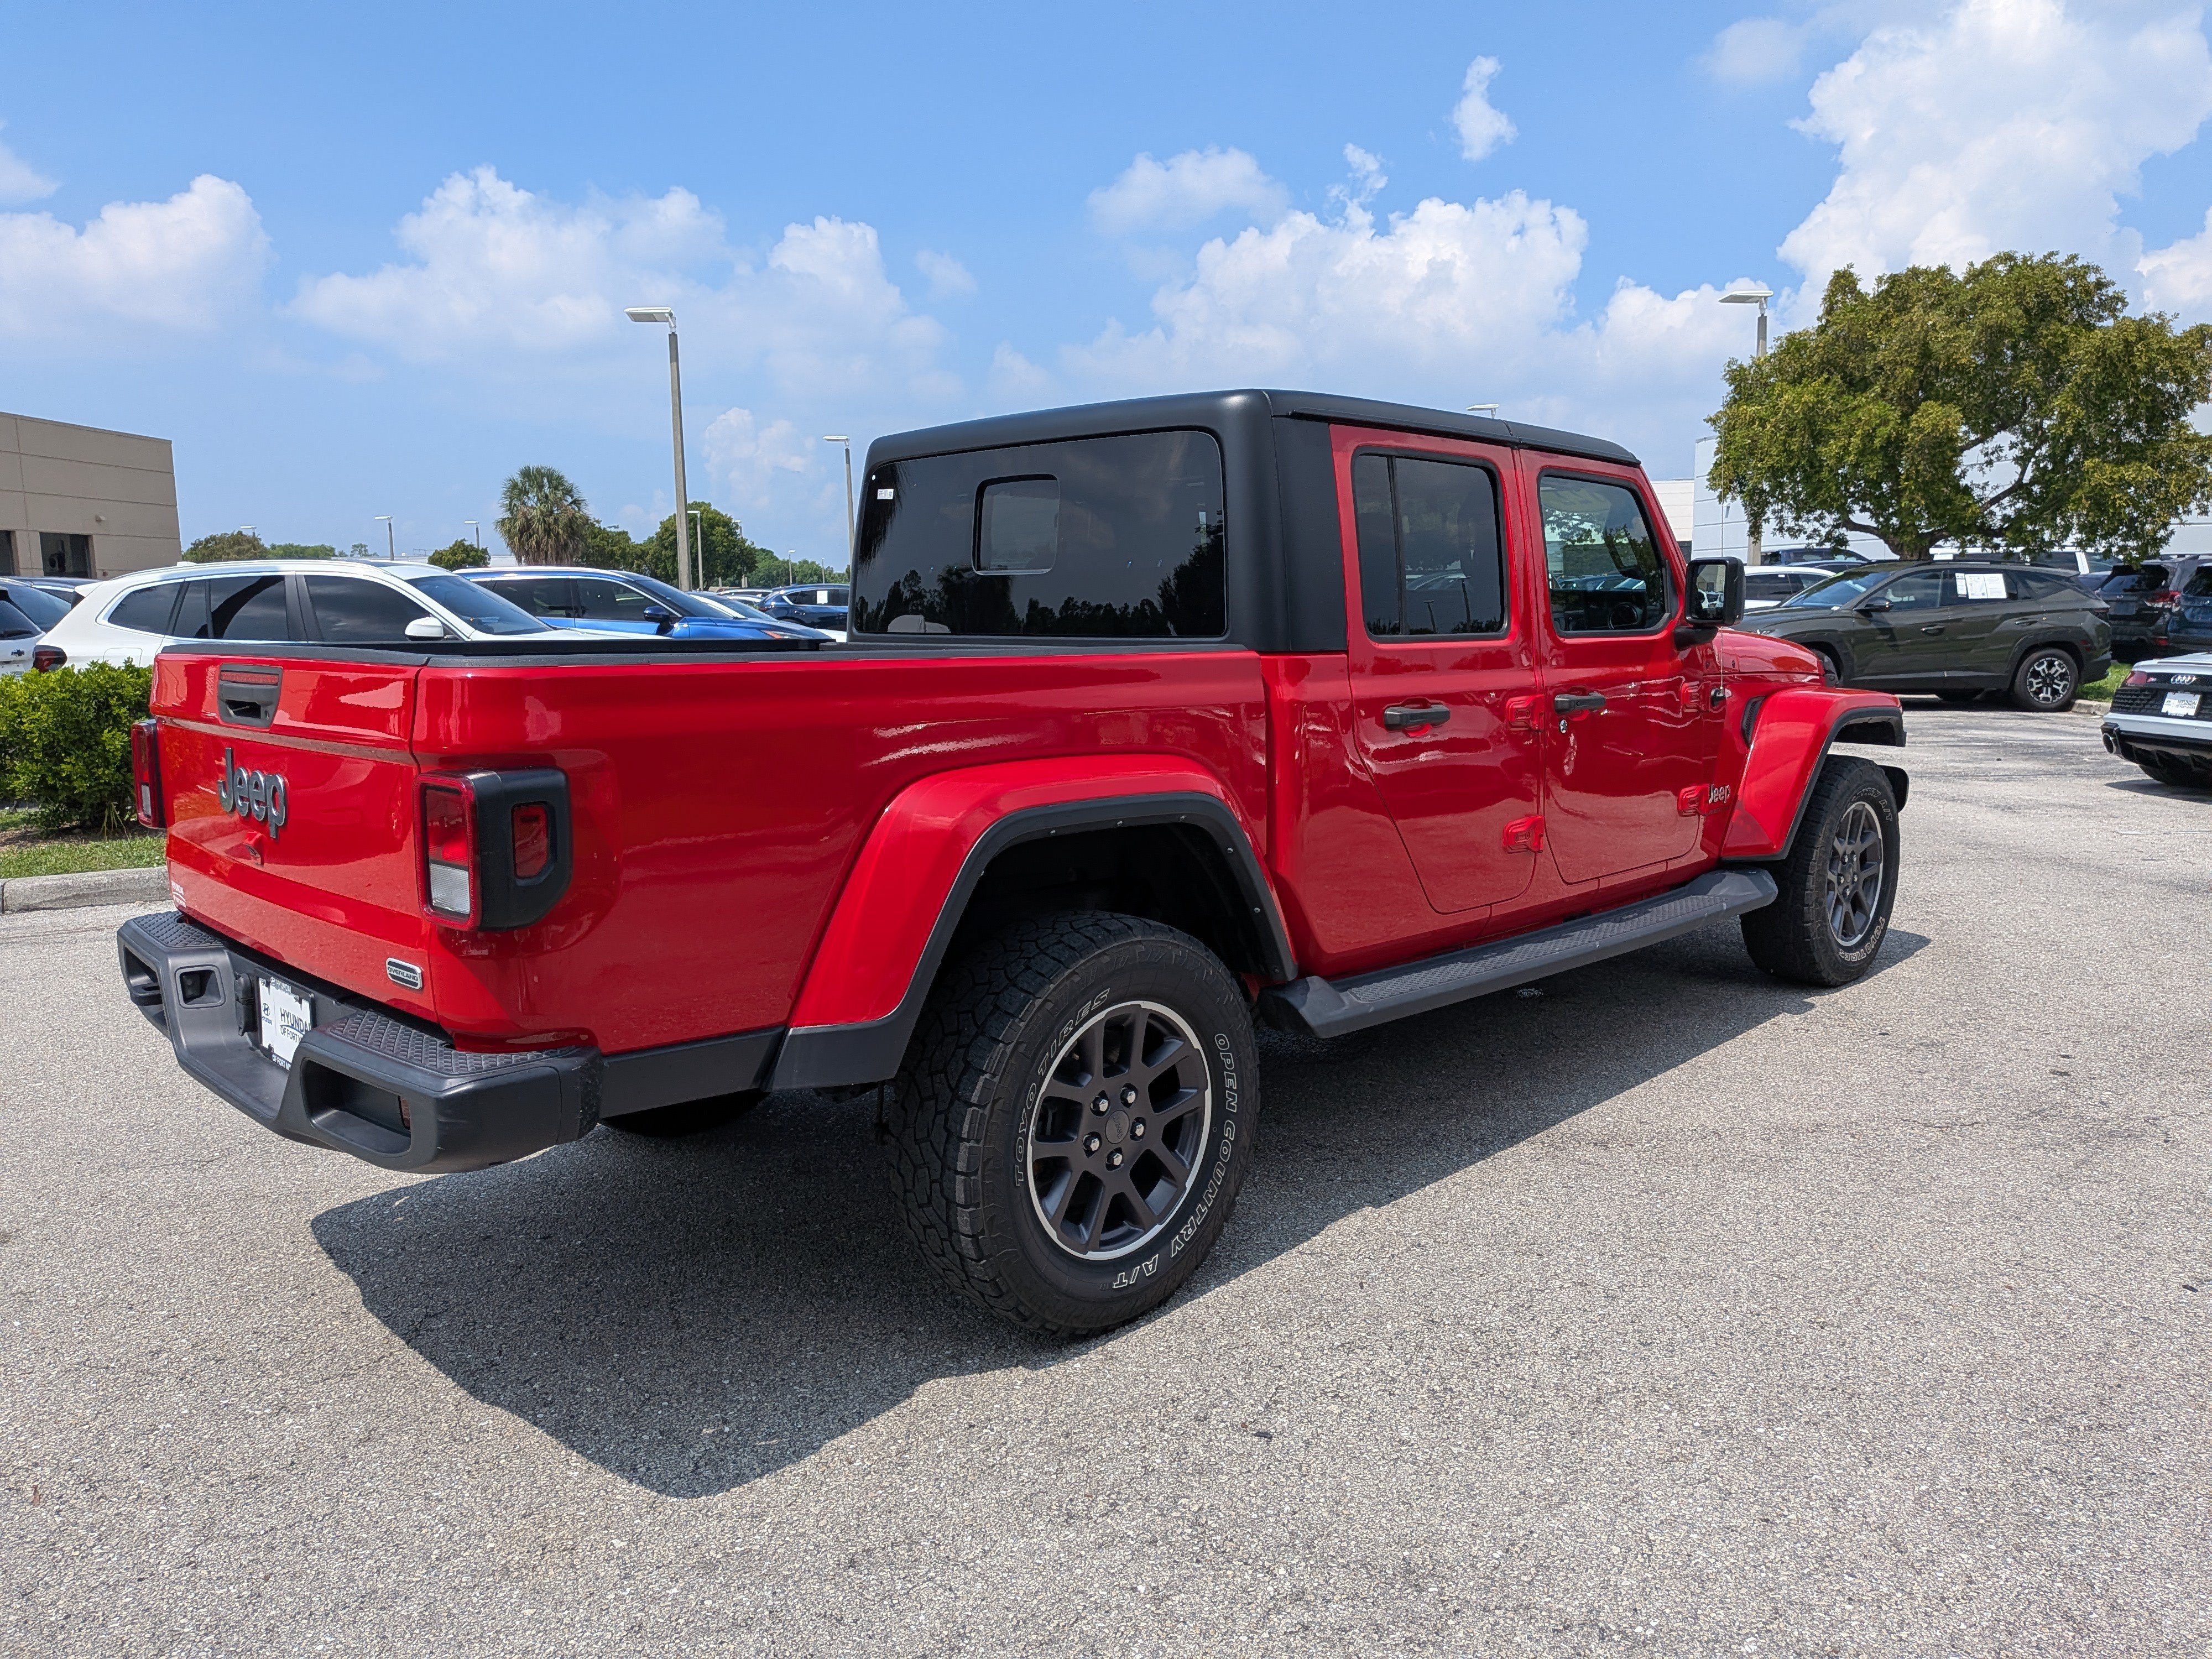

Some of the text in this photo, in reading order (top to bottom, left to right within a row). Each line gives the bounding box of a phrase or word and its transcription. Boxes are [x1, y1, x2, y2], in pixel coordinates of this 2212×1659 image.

[217, 747, 286, 839] Jeep
[1708, 784, 1731, 804] Jeep
[1879, 799, 1892, 821] A/T
[1839, 916, 1886, 962] TOYO TIRES
[387, 967, 419, 982] OVERLAND
[280, 1007, 310, 1032] HYUNDAI
[280, 1025, 286, 1036] OF
[287, 1029, 298, 1042] FORT
[272, 1054, 277, 1062] OF
[277, 1057, 285, 1068] FORT
[1214, 1034, 1238, 1113] OPEN
[1015, 988, 1110, 1187] TOYO TIRES
[1170, 1120, 1236, 1258] COUNTRY
[1113, 1254, 1159, 1288] A/T
